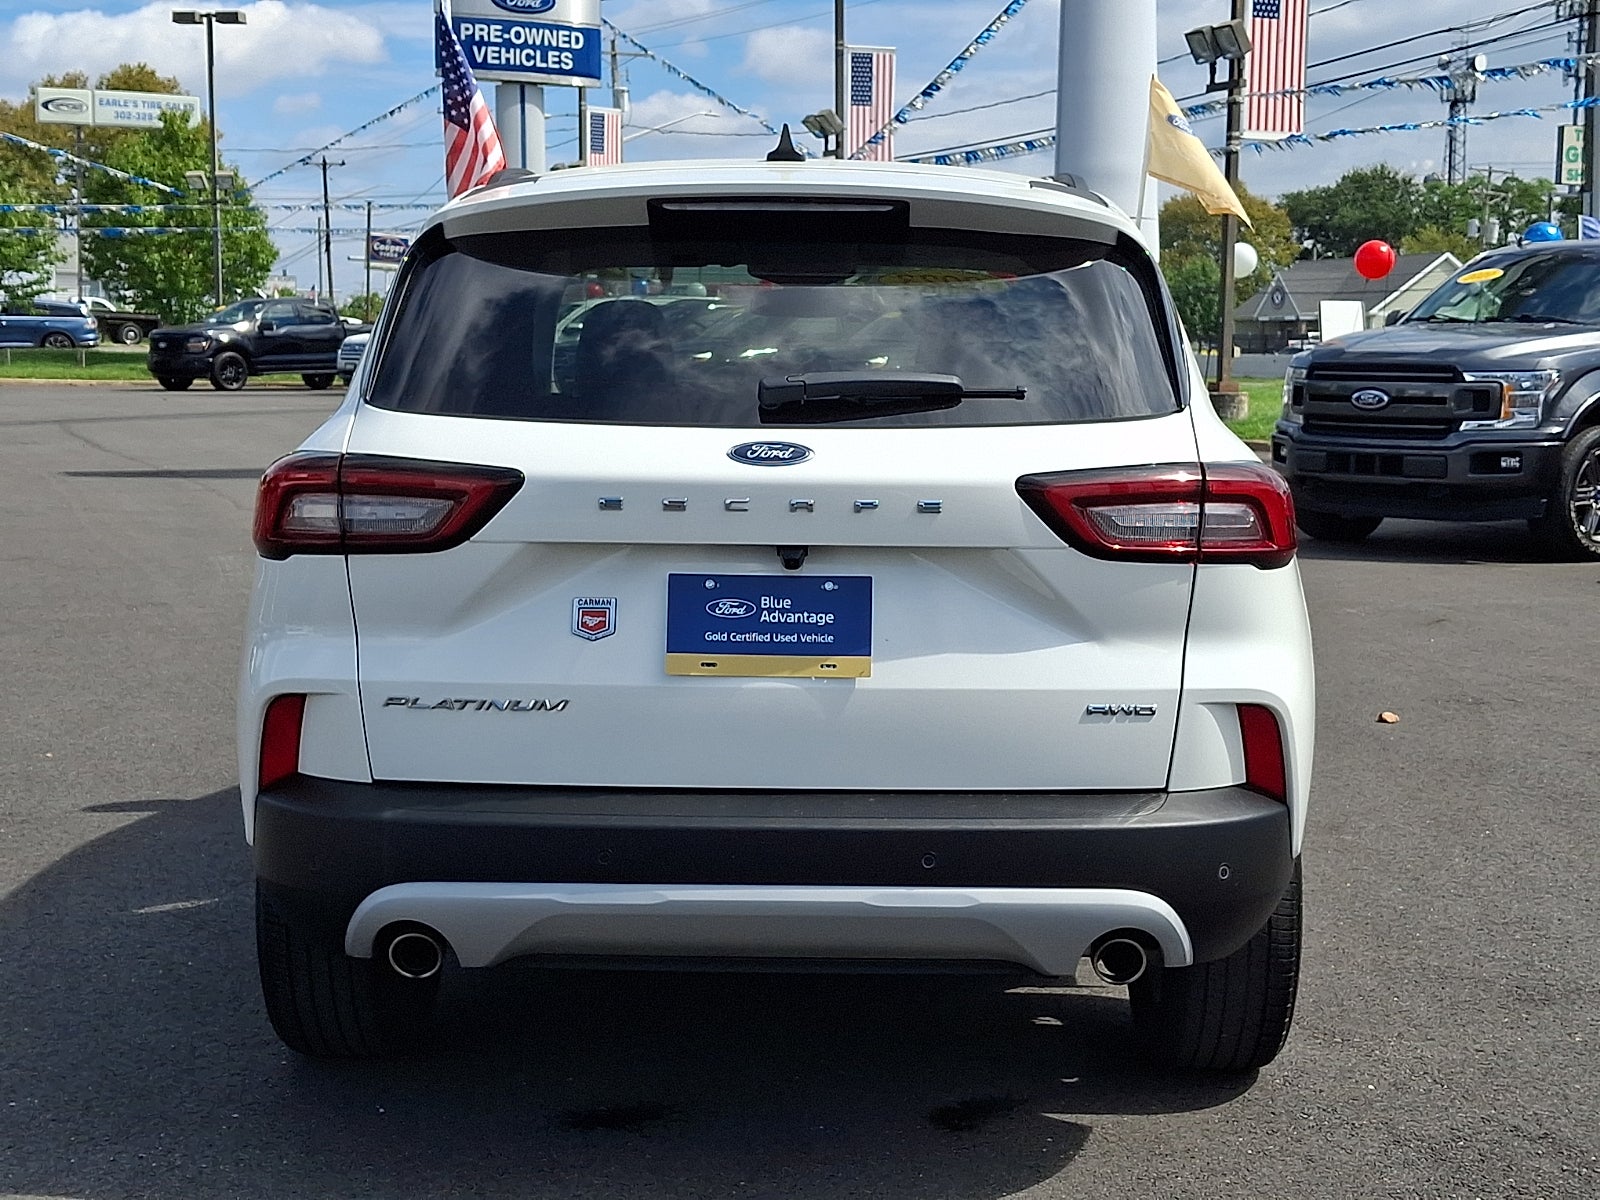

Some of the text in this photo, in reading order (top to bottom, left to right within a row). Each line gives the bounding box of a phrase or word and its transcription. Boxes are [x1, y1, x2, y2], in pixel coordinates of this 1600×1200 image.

[460, 23, 584, 49] PRE-OWNED
[472, 45, 574, 70] VEHICLES
[99, 97, 139, 108] EARLE'S
[142, 99, 162, 110] TIRE
[1574, 129, 1583, 141] T
[373, 241, 405, 253] Cooper
[745, 443, 795, 459] Ford
[598, 496, 944, 513] ESCAPE
[577, 598, 612, 606] CARMAN
[714, 601, 748, 615] Ford
[760, 595, 792, 609] Blue
[759, 610, 835, 626] Advantage
[704, 631, 835, 644] Gold Certified Used Vehicle
[382, 696, 571, 712] PLATINUM
[1086, 703, 1158, 716] AWD
